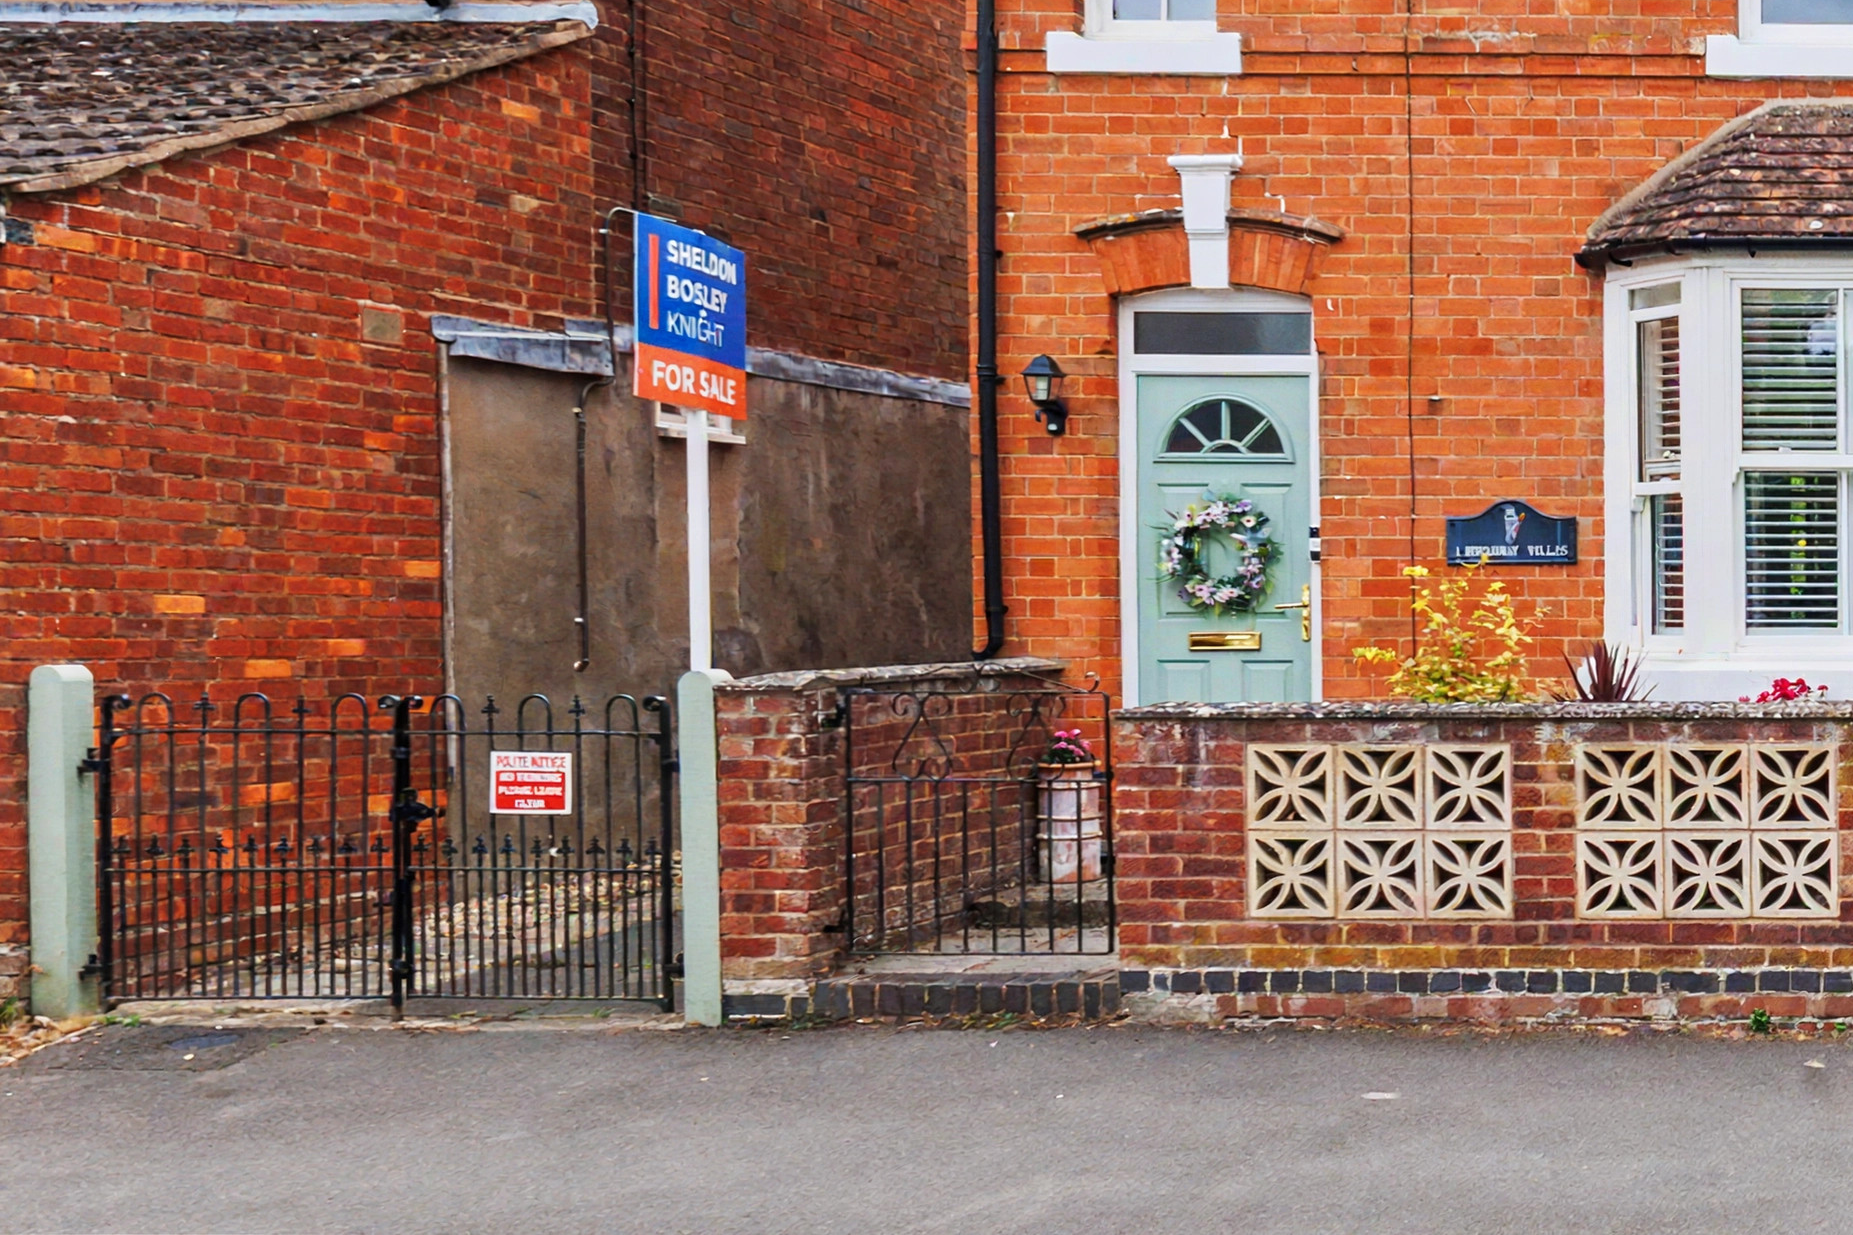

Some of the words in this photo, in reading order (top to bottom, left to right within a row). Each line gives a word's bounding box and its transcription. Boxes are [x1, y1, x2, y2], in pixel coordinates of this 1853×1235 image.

[666, 239, 737, 286] SHELDON
[666, 274, 728, 314] BOSLEY
[666, 310, 725, 348] KNIGHT
[652, 360, 696, 395] FOR
[699, 371, 737, 406] SALE
